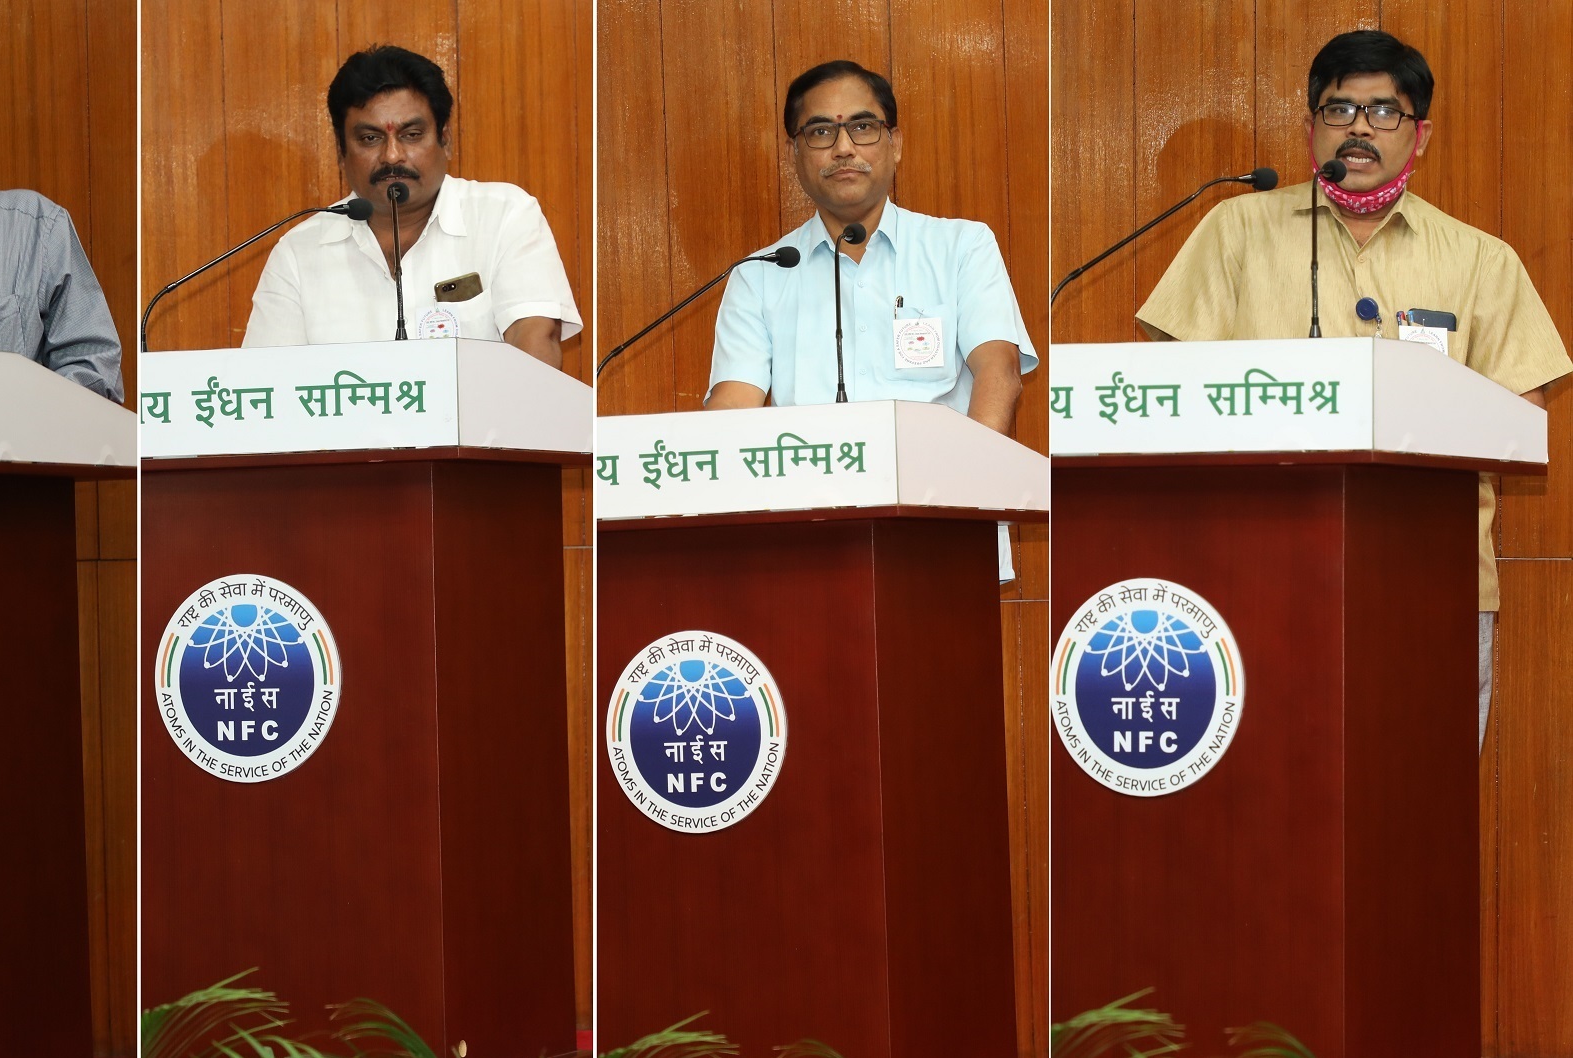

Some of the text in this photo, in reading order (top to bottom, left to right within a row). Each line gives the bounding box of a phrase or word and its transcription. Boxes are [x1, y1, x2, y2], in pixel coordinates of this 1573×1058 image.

[192, 377, 273, 427] ईंधन
[296, 371, 425, 416] सम्मिश्र
[1096, 372, 1179, 423] ईंधन
[1205, 368, 1339, 415] सम्मिश्र
[640, 440, 717, 488] ईंधन
[741, 433, 865, 477] सम्मिश्र
[177, 578, 315, 631] राष्ट्र की सेवा में परमाणु
[1074, 583, 1218, 639] राष्ट्र की सेवा में परमाणु
[627, 634, 761, 686] राष्ट्र की सेवा में परमाणु
[161, 689, 334, 779] ATOMS IN THE SERVICE OF THE NATION
[217, 719, 279, 741] NFC
[1056, 700, 1236, 792] ATOMS IN THE SERVICE OF THE NATION
[1113, 730, 1178, 754] NFC
[612, 742, 780, 829] ATOMS IN THE SERVICE OF THE NATION
[667, 771, 727, 794] NFC
